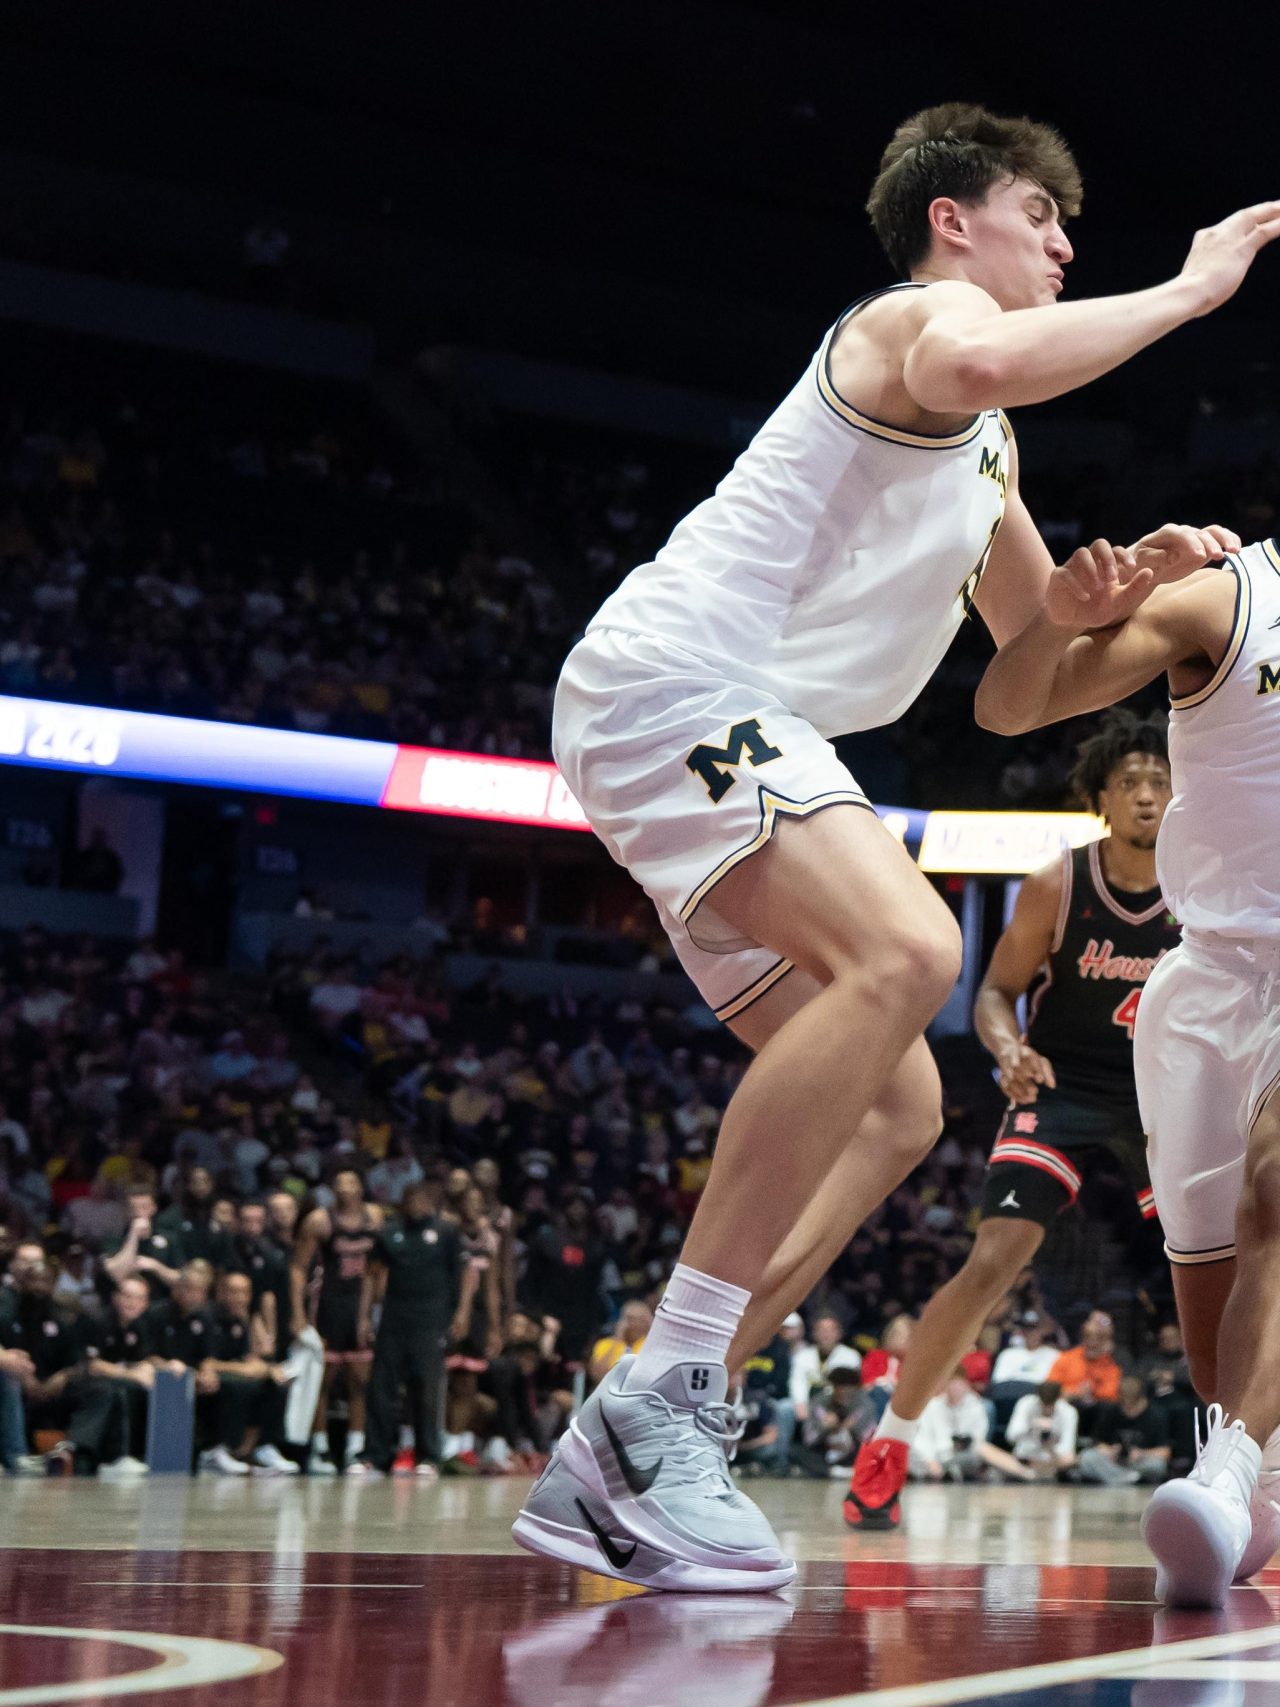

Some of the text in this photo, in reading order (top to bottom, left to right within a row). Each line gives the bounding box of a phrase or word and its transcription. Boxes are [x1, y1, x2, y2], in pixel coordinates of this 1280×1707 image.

[685, 717, 784, 807] M
[1077, 938, 1157, 981] Hous
[1112, 987, 1144, 1040] 4
[690, 1368, 709, 1391] S
